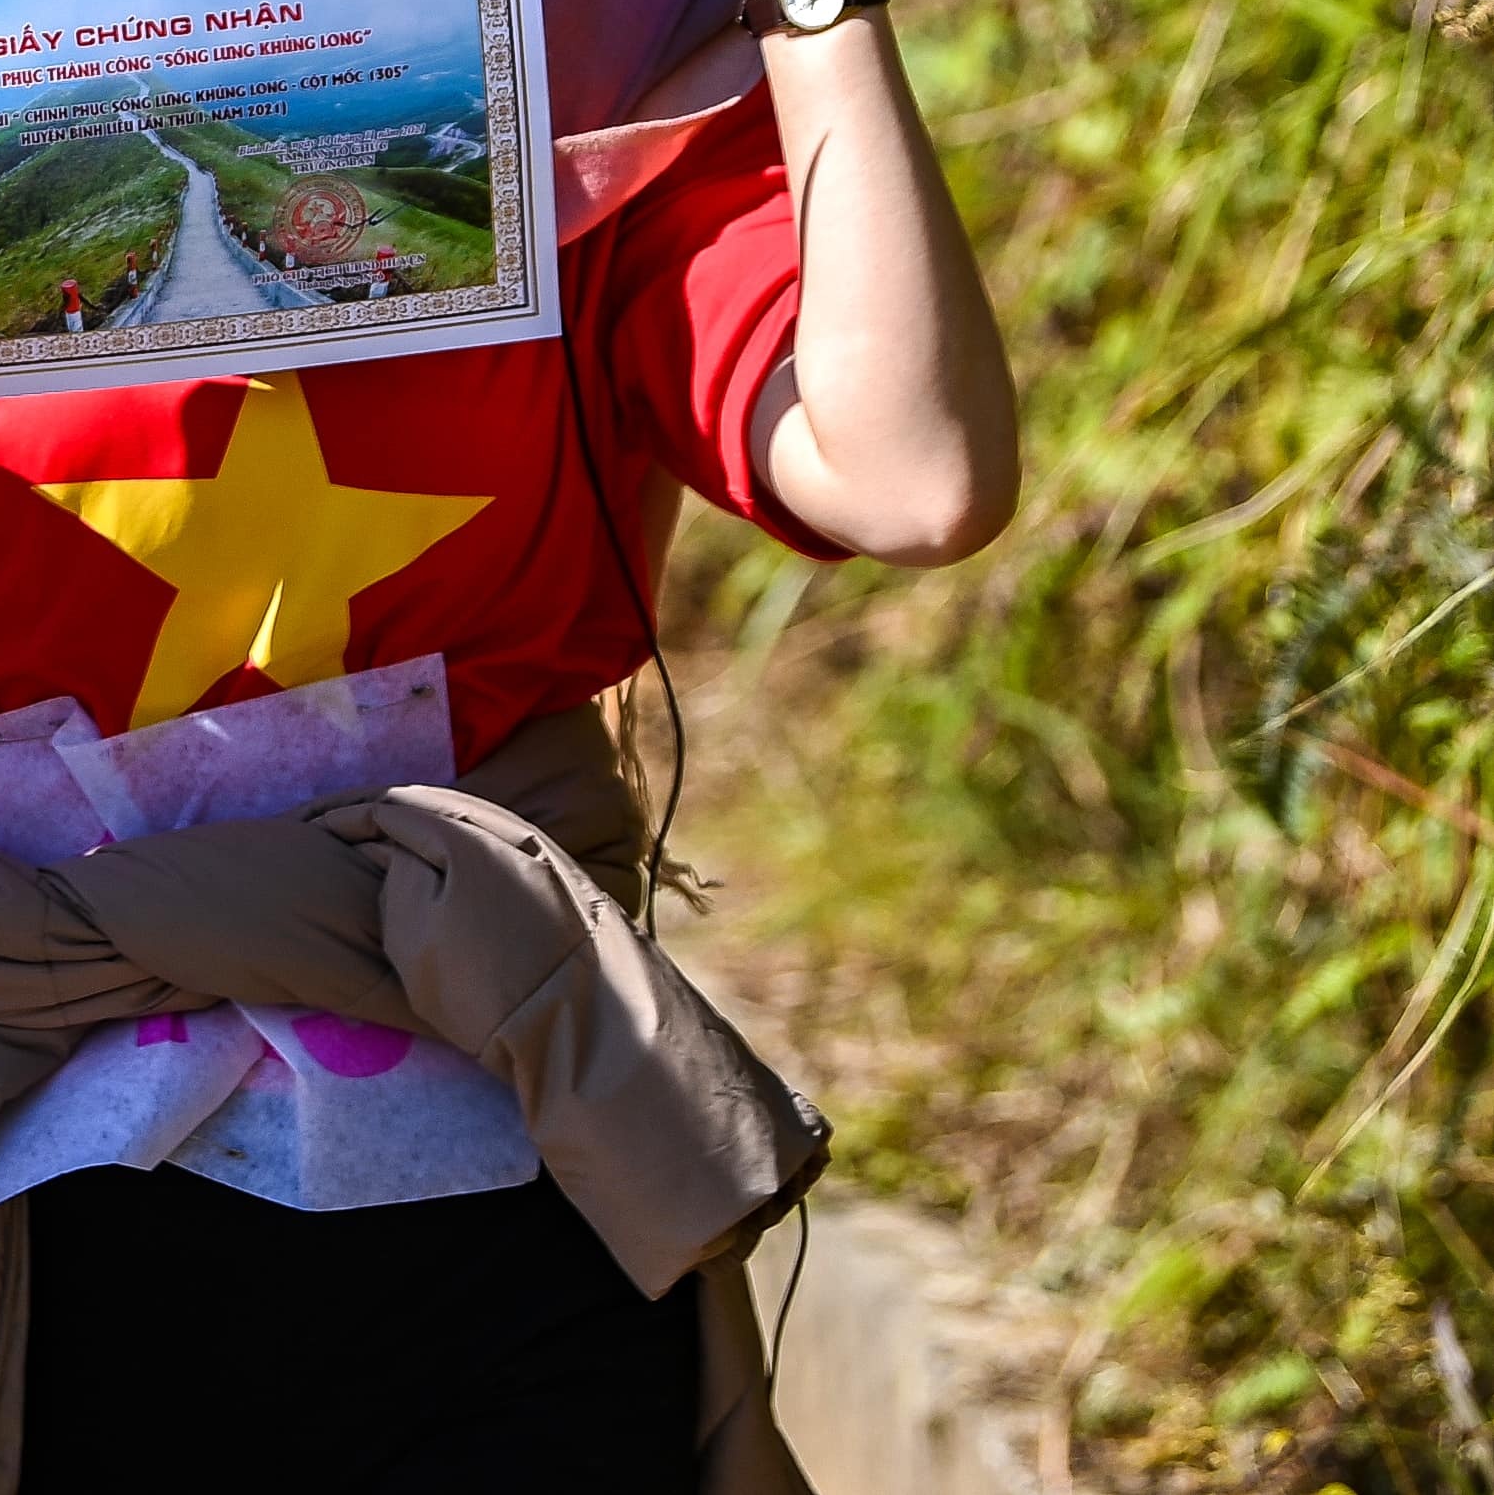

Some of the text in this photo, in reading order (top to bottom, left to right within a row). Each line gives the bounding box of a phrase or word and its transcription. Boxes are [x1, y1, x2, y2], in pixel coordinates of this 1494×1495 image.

[75, 10, 192, 47] CHỨNG
[1, 68, 43, 89] PHỤC
[105, 53, 151, 74] CÔNG
[213, 42, 255, 61] LƯNG
[259, 32, 315, 55] KHỦNG
[25, 106, 68, 123] CHINH
[249, 79, 287, 95] LONG
